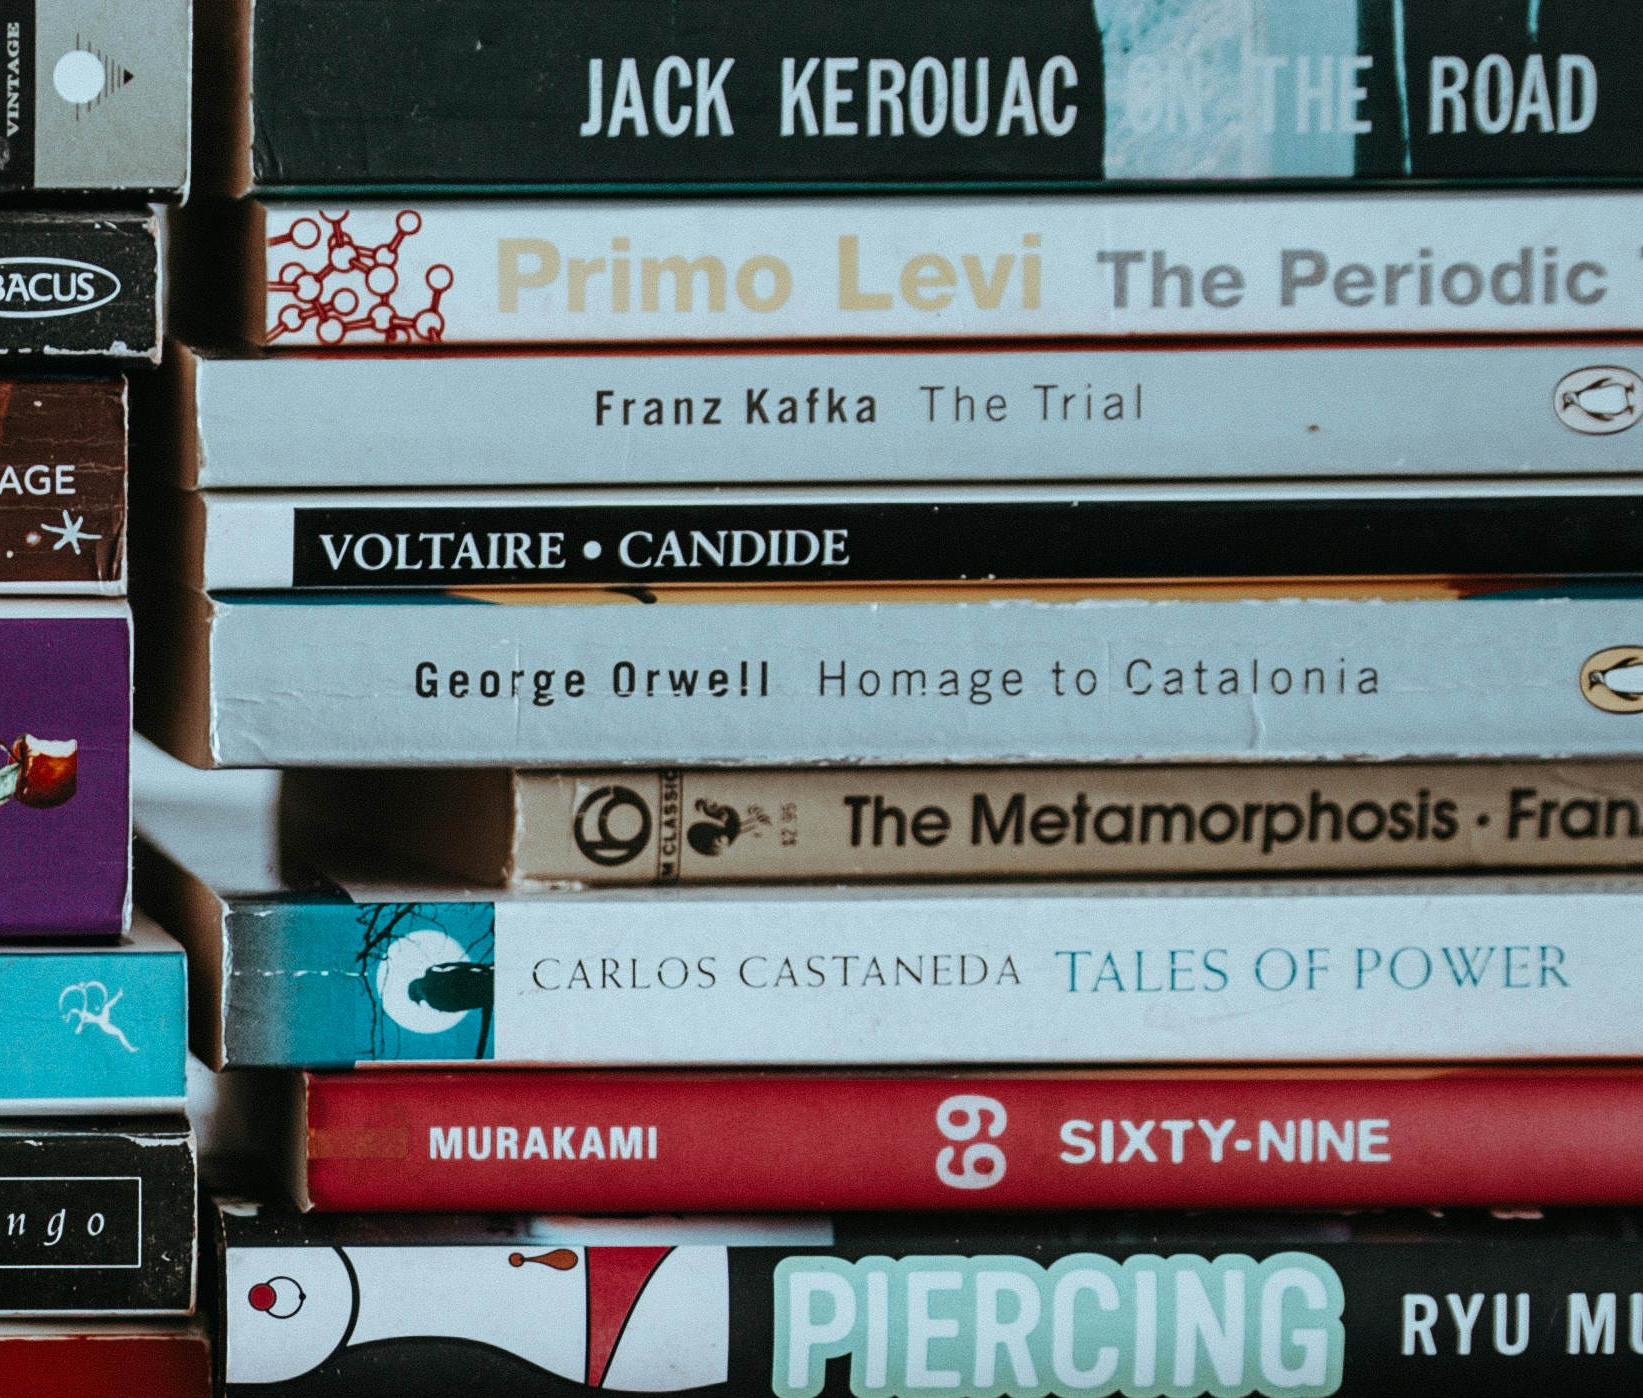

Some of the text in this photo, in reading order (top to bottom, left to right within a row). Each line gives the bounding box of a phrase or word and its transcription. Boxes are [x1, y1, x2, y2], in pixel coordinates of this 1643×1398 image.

[6, 22, 20, 137] VINTAGE
[580, 54, 1597, 137] JACK KEROUAC ROAD
[498, 233, 1607, 314] Primo Levi The Periodic
[596, 383, 1142, 426] Franz Kafka The Trial
[320, 529, 849, 570] VOLTAIRE CANDIDE
[843, 795, 951, 847] The
[971, 788, 1458, 853] Metamorphosis
[429, 1126, 657, 1160] MURAKAMI
[1060, 1118, 1391, 1164] SIXTY-NINE
[786, 1270, 1328, 1390] PIERCING
